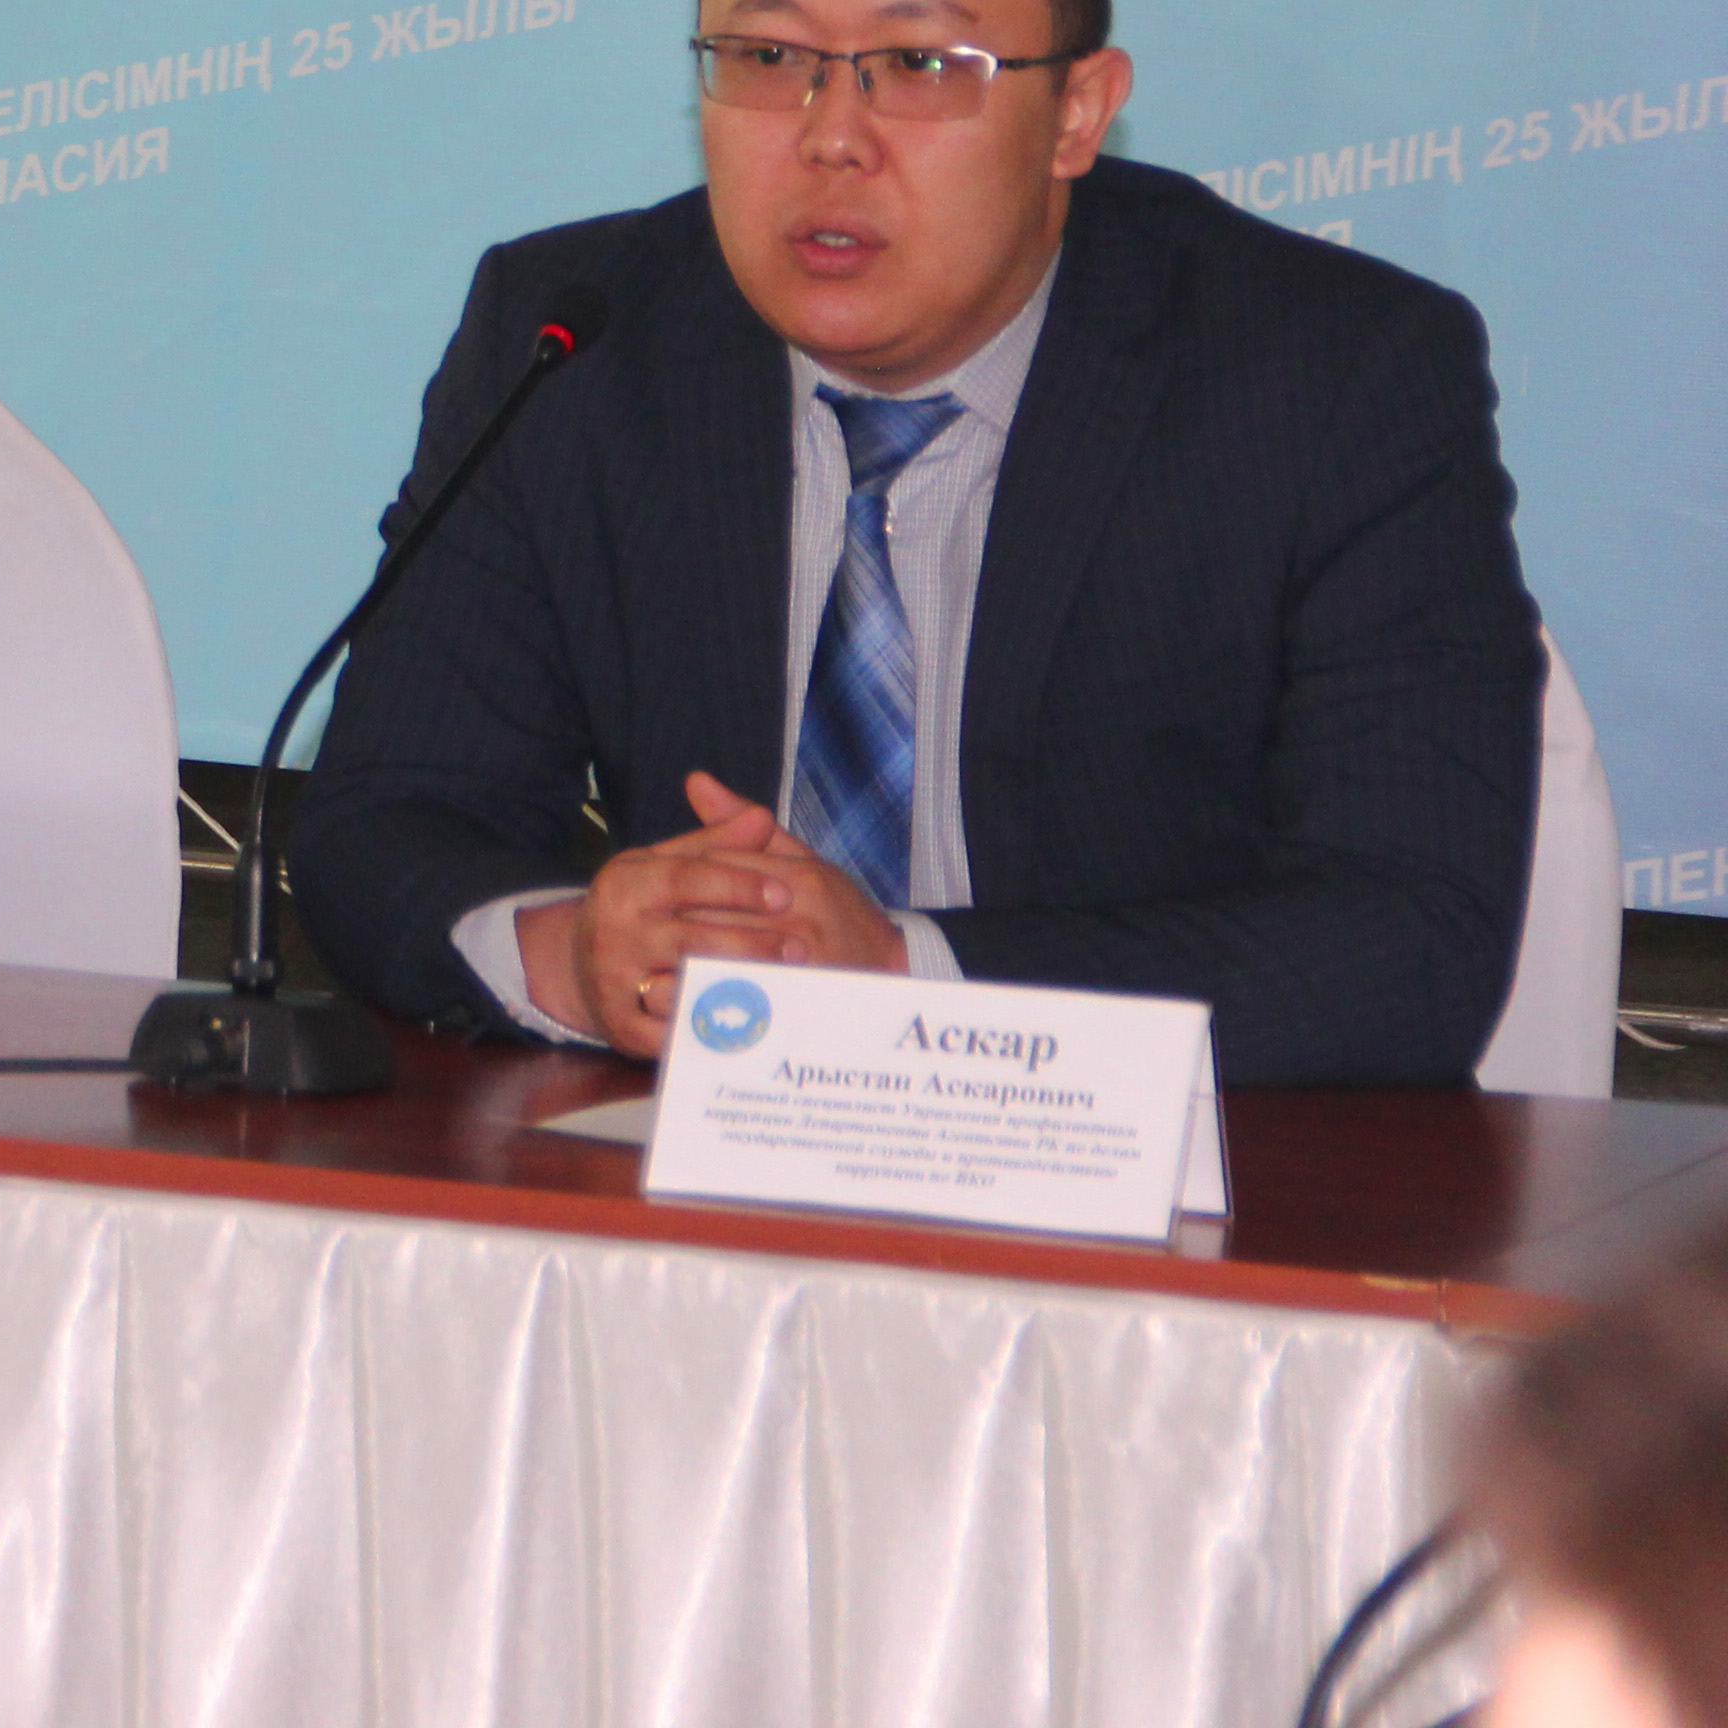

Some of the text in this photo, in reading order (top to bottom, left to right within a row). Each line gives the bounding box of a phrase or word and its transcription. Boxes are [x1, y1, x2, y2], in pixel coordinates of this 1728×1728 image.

[288, 20, 355, 78] 25
[1481, 109, 1552, 169] 25
[895, 1012, 1060, 1072] Аскар
[773, 1058, 1095, 1112] Арыстан Аскарович
